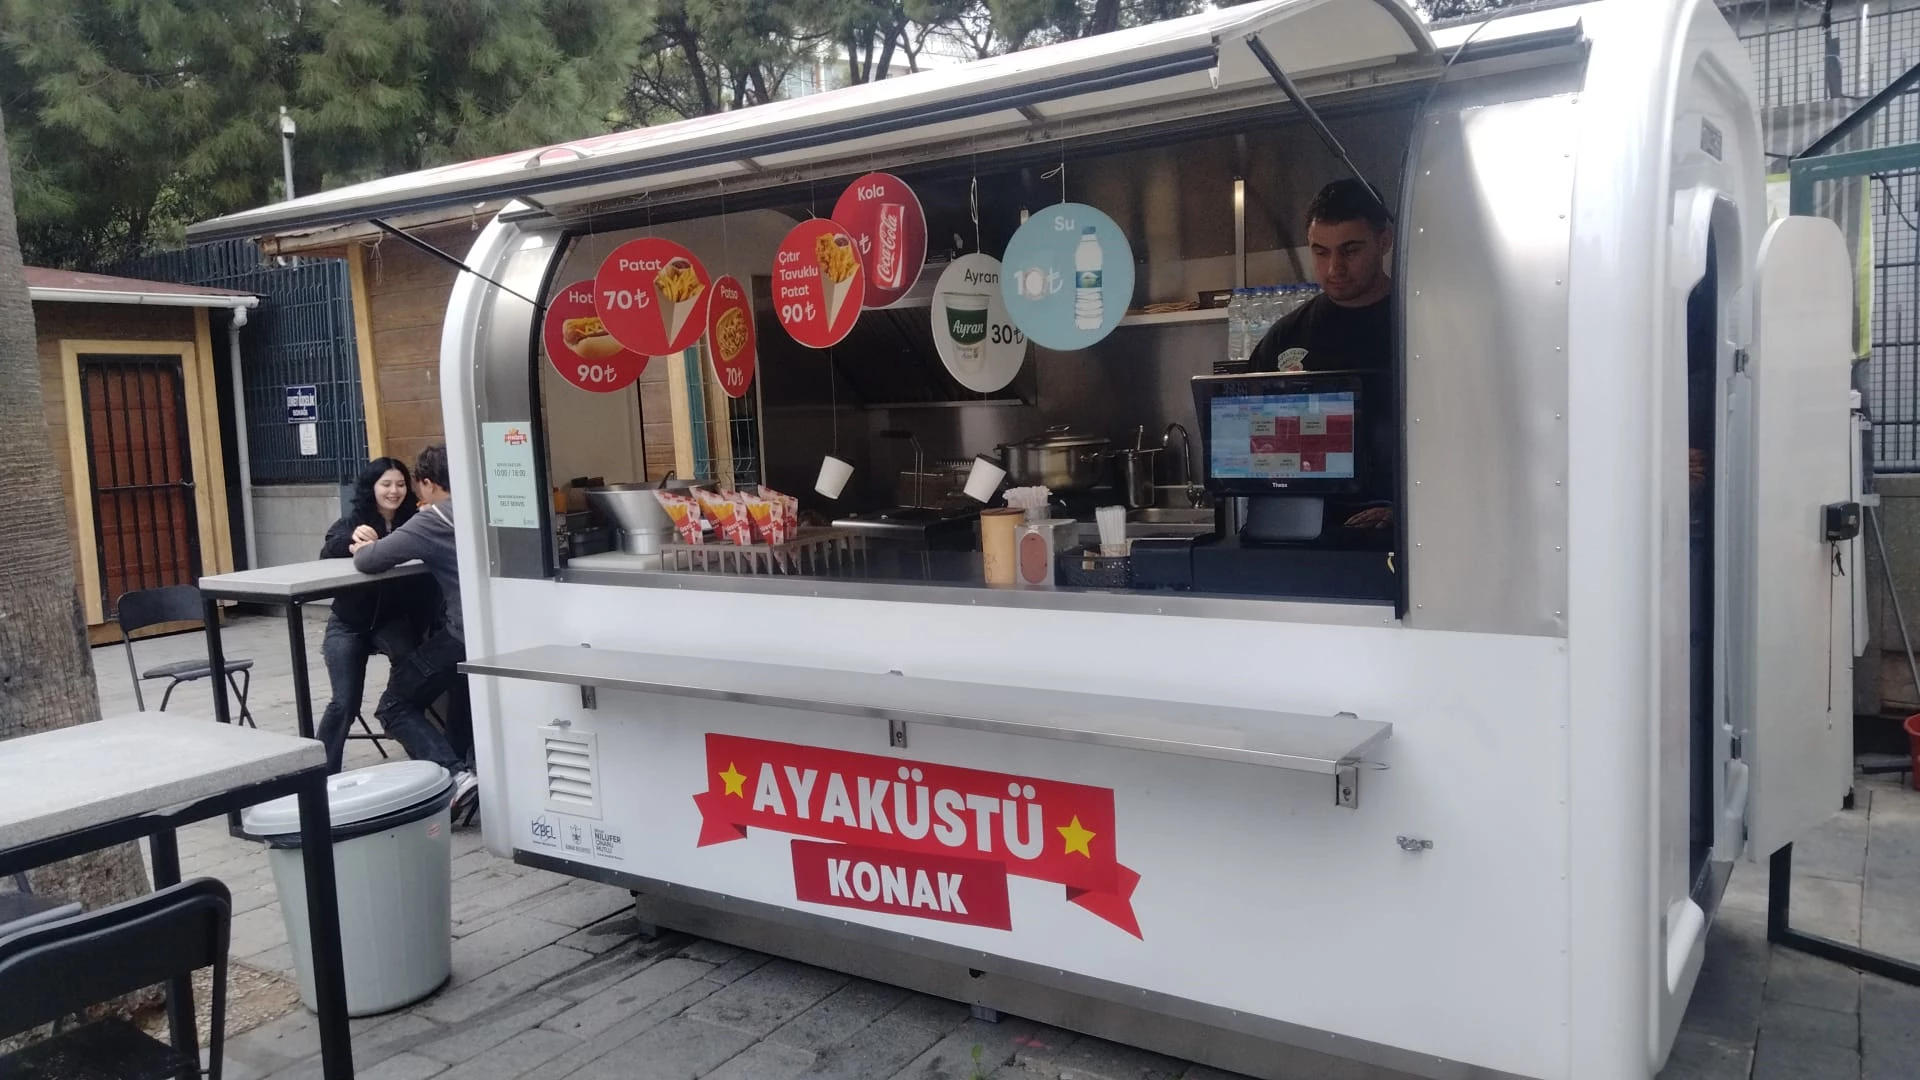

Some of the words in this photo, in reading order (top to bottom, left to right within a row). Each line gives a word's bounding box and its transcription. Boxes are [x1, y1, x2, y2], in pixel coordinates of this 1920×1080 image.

[857, 185, 885, 201] Kola
[1054, 216, 1075, 231] Su
[619, 258, 661, 272] Patat
[778, 250, 802, 265] Çıtır
[779, 265, 819, 281] Tavuklu
[963, 268, 999, 286] Ayran
[569, 291, 593, 304] Hot
[603, 288, 650, 311] 70₺
[781, 285, 810, 299] Patat
[782, 302, 817, 324] 90₺
[952, 319, 985, 339] Ayran
[991, 324, 1025, 345] 30₺
[577, 363, 618, 384] 90₺
[726, 367, 744, 387] 70₺
[751, 761, 1045, 861] AYAKÜSTÜ
[827, 857, 969, 915] KONAK
